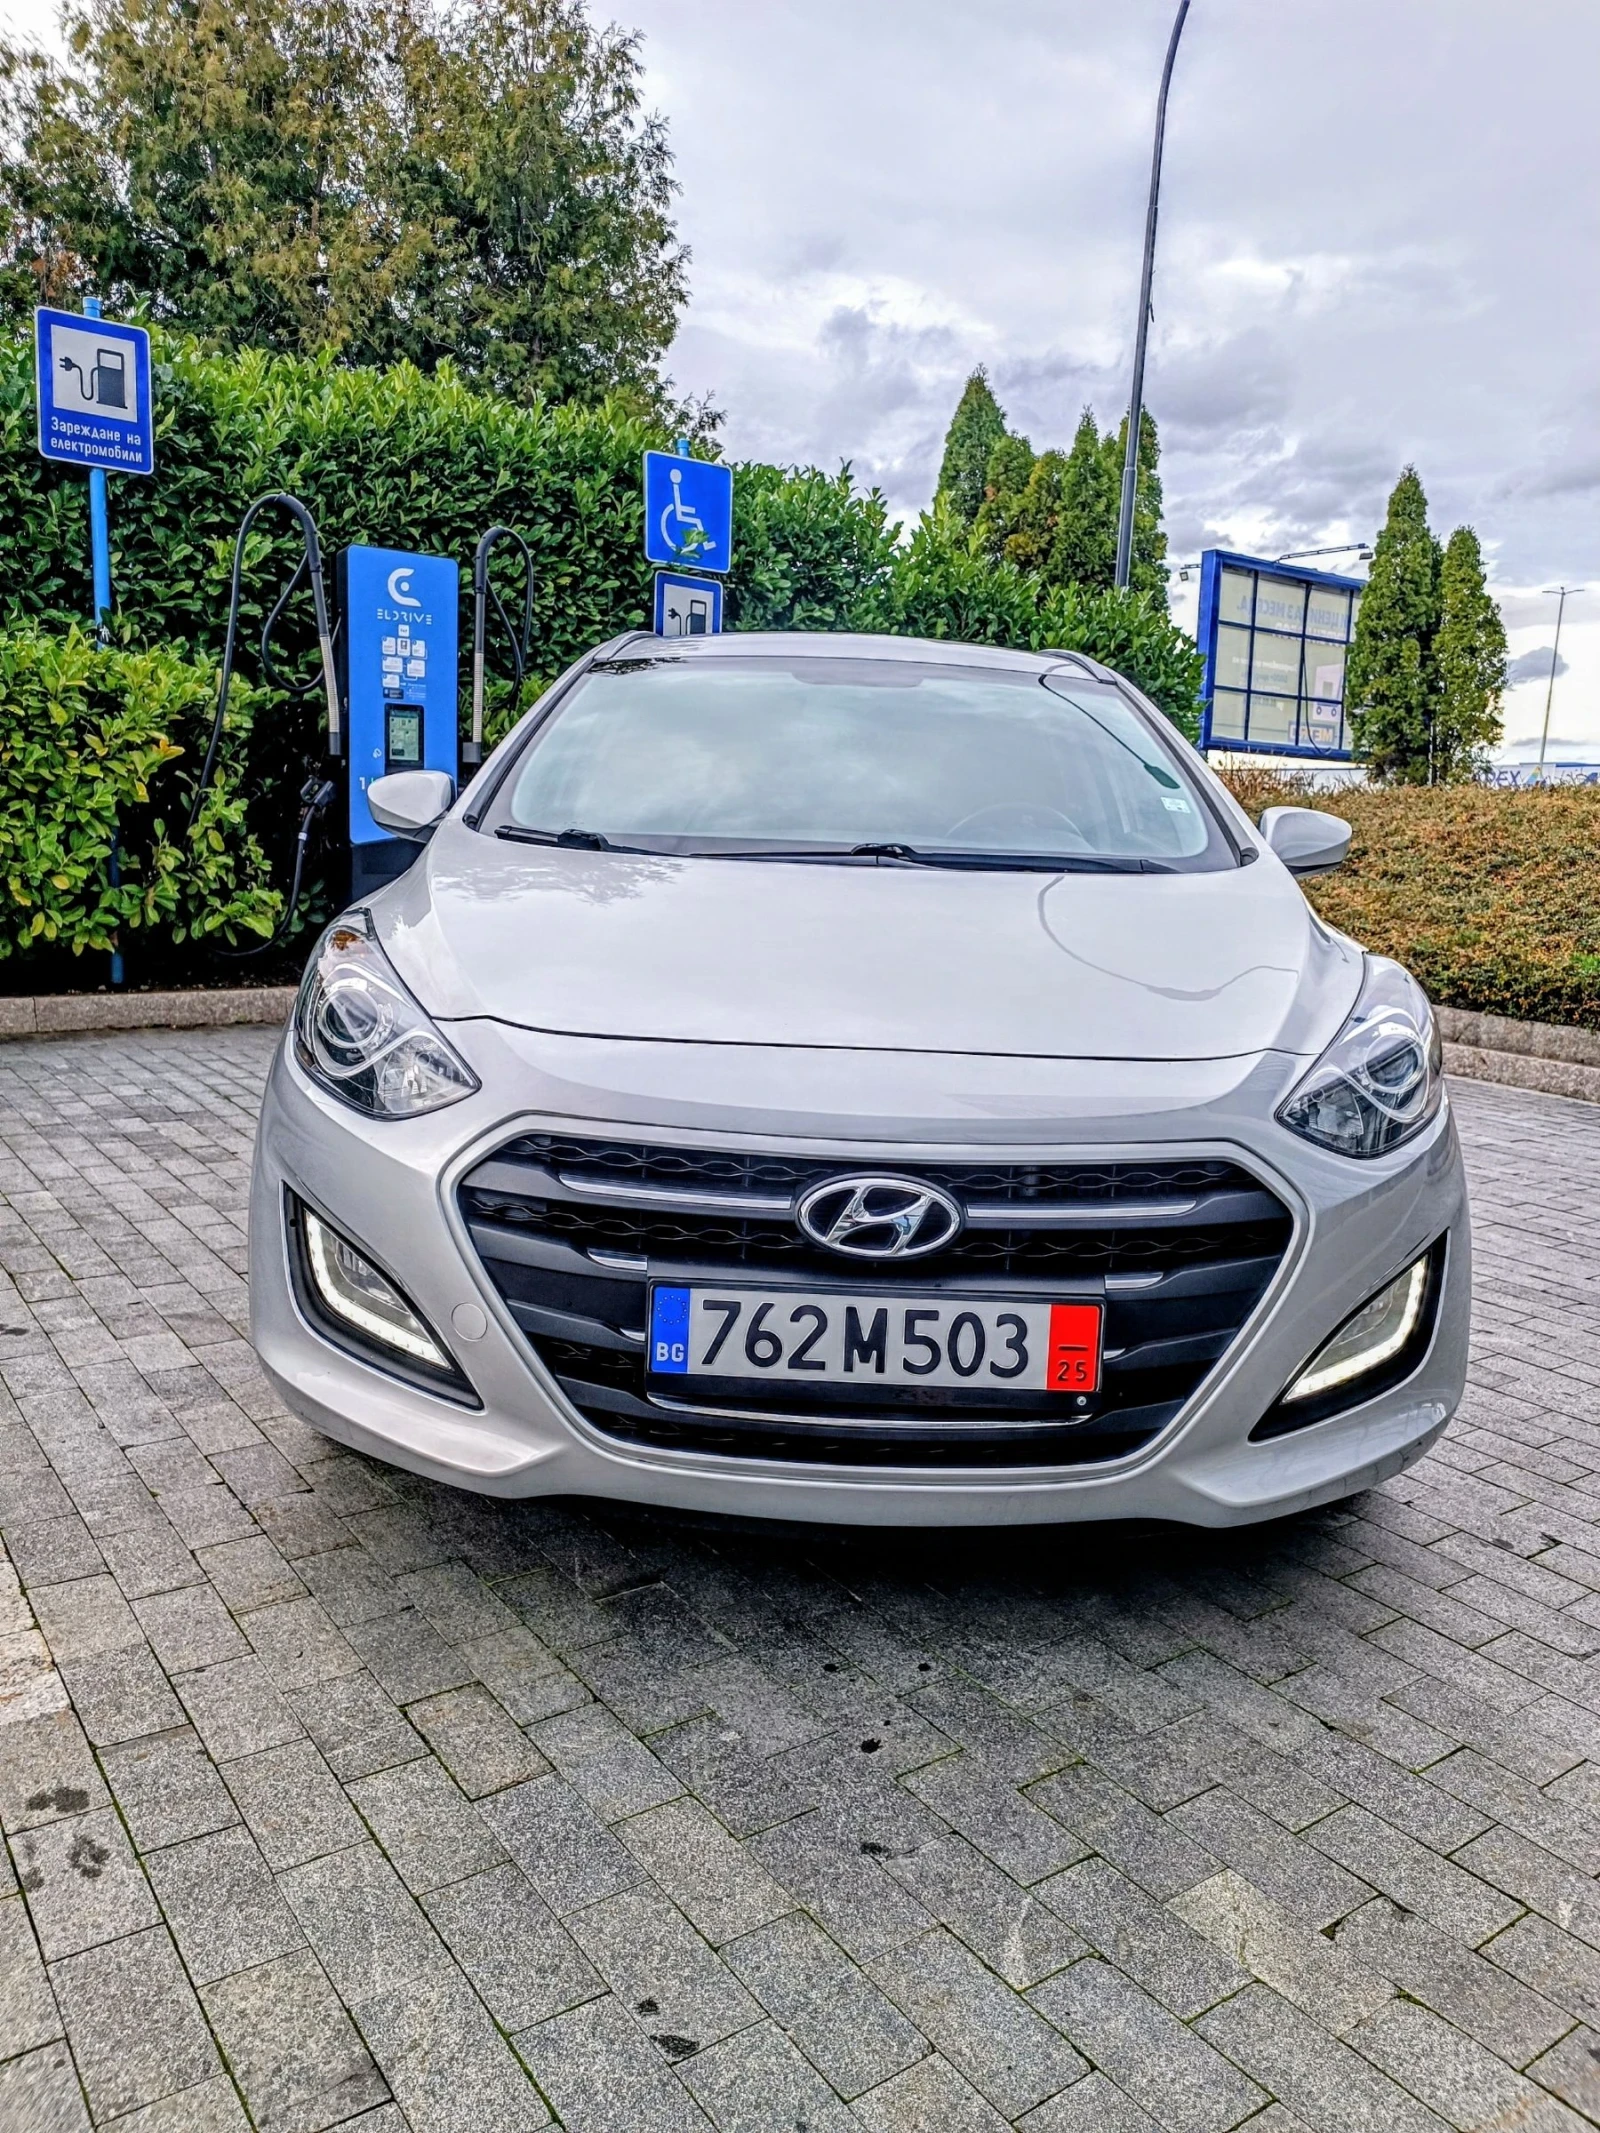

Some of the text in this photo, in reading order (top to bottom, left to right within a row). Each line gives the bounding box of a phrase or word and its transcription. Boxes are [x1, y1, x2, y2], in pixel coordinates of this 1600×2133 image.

[51, 416, 141, 446] Зареждане на
[50, 437, 142, 463] електромобили
[377, 608, 432, 625] ELDRIVE
[656, 1343, 684, 1362] BG
[1056, 1361, 1088, 1382] 25
